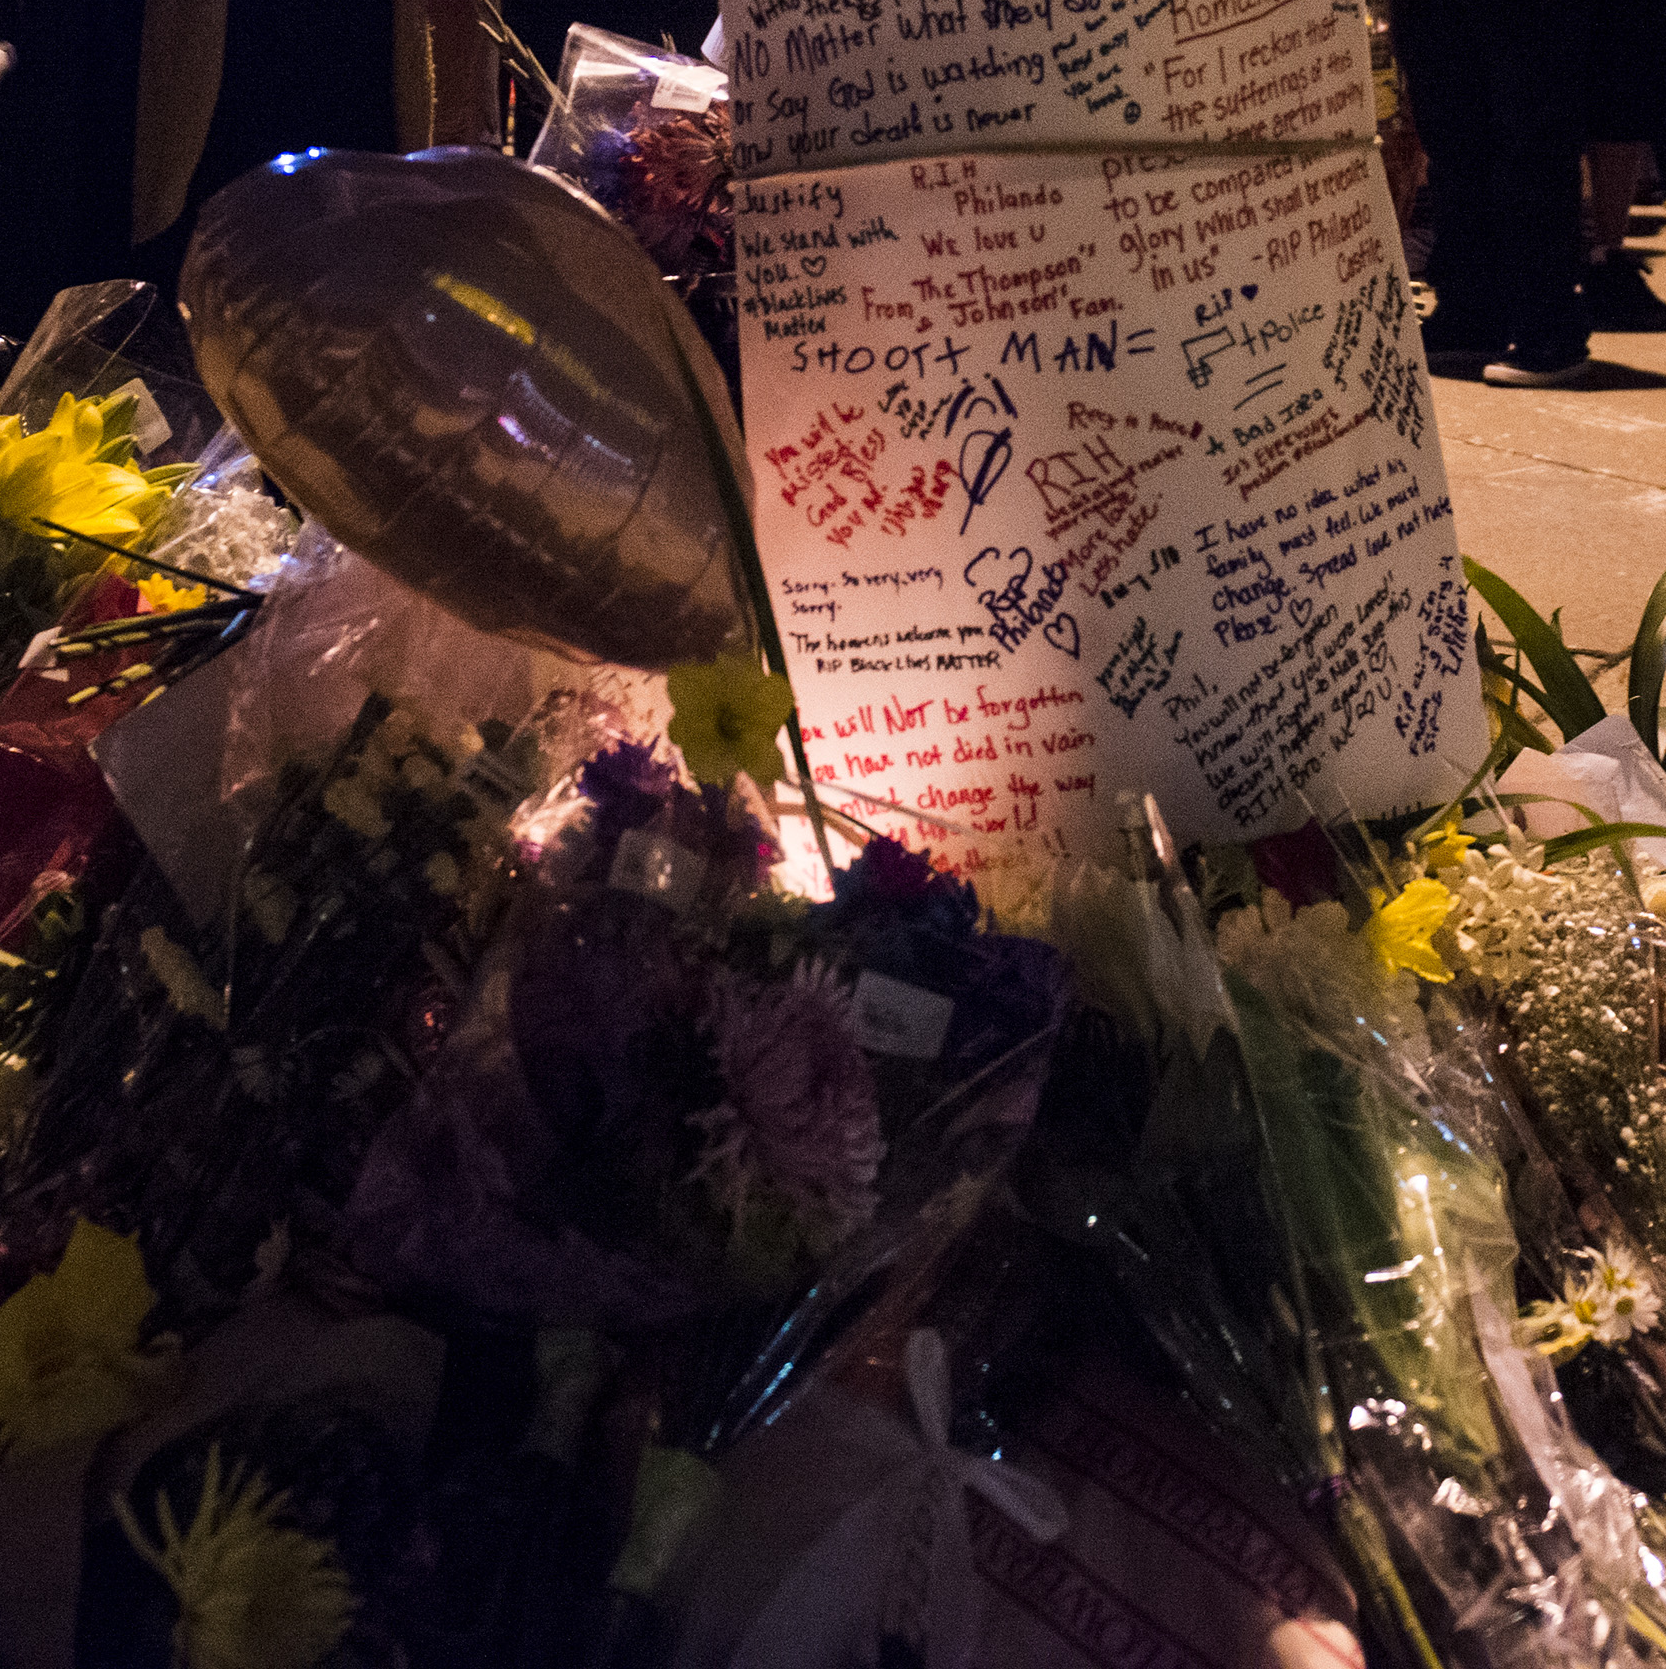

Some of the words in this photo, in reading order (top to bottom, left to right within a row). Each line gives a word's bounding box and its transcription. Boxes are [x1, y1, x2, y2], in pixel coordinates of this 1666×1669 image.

[735, 31, 770, 86] NO
[785, 22, 880, 76] Matter
[1238, 27, 1303, 73] reckon
[828, 69, 876, 111] God
[888, 56, 908, 95] is
[923, 45, 1046, 91] watching
[1161, 98, 1208, 133] the
[788, 126, 839, 166] your
[955, 184, 1063, 217] Philando
[1104, 196, 1140, 223] to
[1145, 190, 1181, 216] be
[741, 231, 775, 258] We
[781, 224, 841, 253] stand
[848, 216, 899, 249] with
[1119, 223, 1186, 274] glory
[1195, 205, 1258, 244] which
[1150, 253, 1175, 292] in
[861, 286, 915, 322] From
[1000, 319, 1118, 374] MAN
[1194, 524, 1221, 554] I
[1225, 516, 1269, 544] have
[1275, 502, 1299, 524] no
[1206, 546, 1273, 582] family
[834, 704, 874, 742] will
[944, 698, 970, 725] be
[977, 682, 1084, 731] forgotten
[906, 743, 944, 769] not
[953, 736, 999, 765] died
[1004, 734, 1033, 758] in
[916, 784, 997, 817] change
